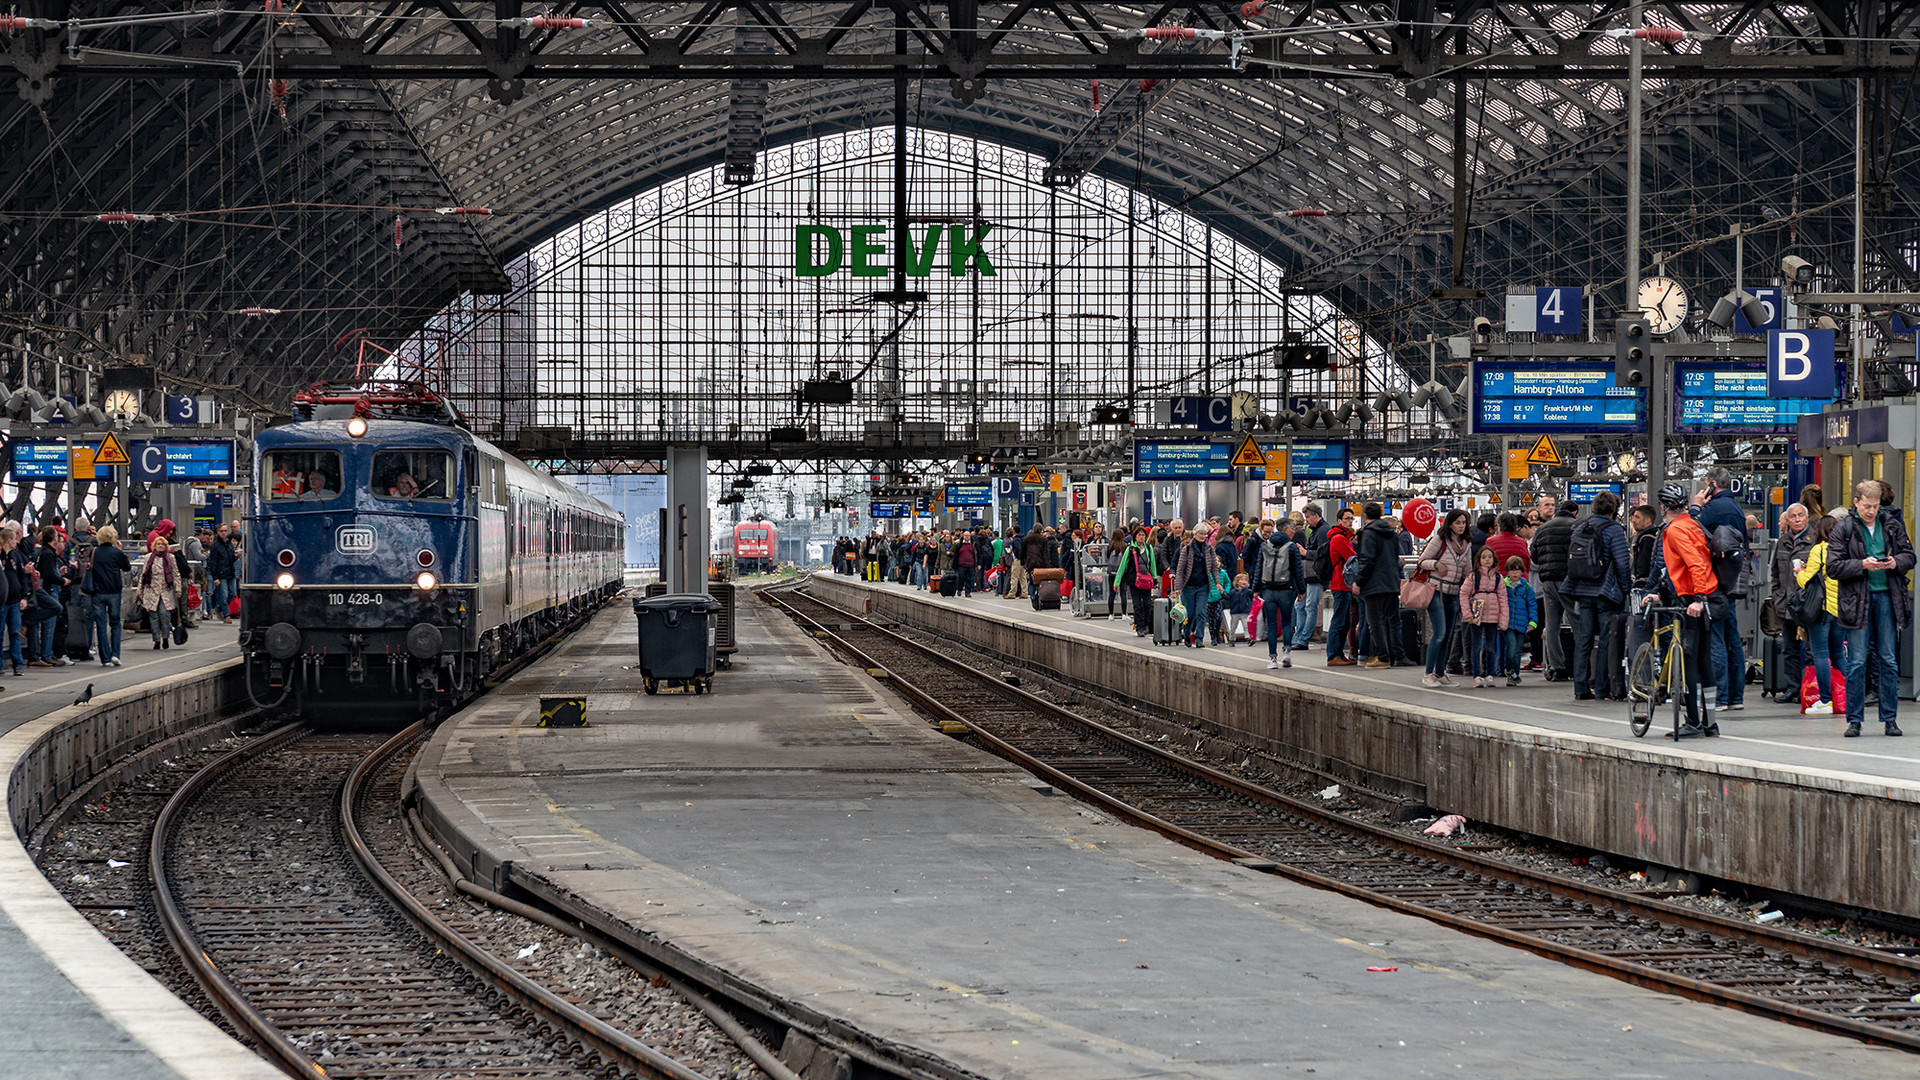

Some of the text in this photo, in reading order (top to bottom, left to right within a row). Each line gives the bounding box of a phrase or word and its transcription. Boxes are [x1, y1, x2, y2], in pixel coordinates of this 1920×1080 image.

[796, 224, 997, 276] DEVK
[1541, 288, 1564, 323] 4
[1778, 333, 1811, 381] B
[926, 379, 997, 407] HBF
[1514, 385, 1584, 396] Hamburg-Altona
[179, 398, 193, 418] 3
[1174, 398, 1187, 418] 4
[1208, 398, 1227, 424] C
[1296, 398, 1309, 417] 5
[142, 447, 162, 473] C
[1589, 458, 1597, 470] 6
[1001, 479, 1012, 494] D
[1731, 480, 1741, 492] D
[893, 507, 899, 515] F
[916, 497, 924, 509] E
[1446, 500, 1452, 510] E
[344, 534, 369, 545] TRI
[329, 594, 383, 605] 110 428-0
